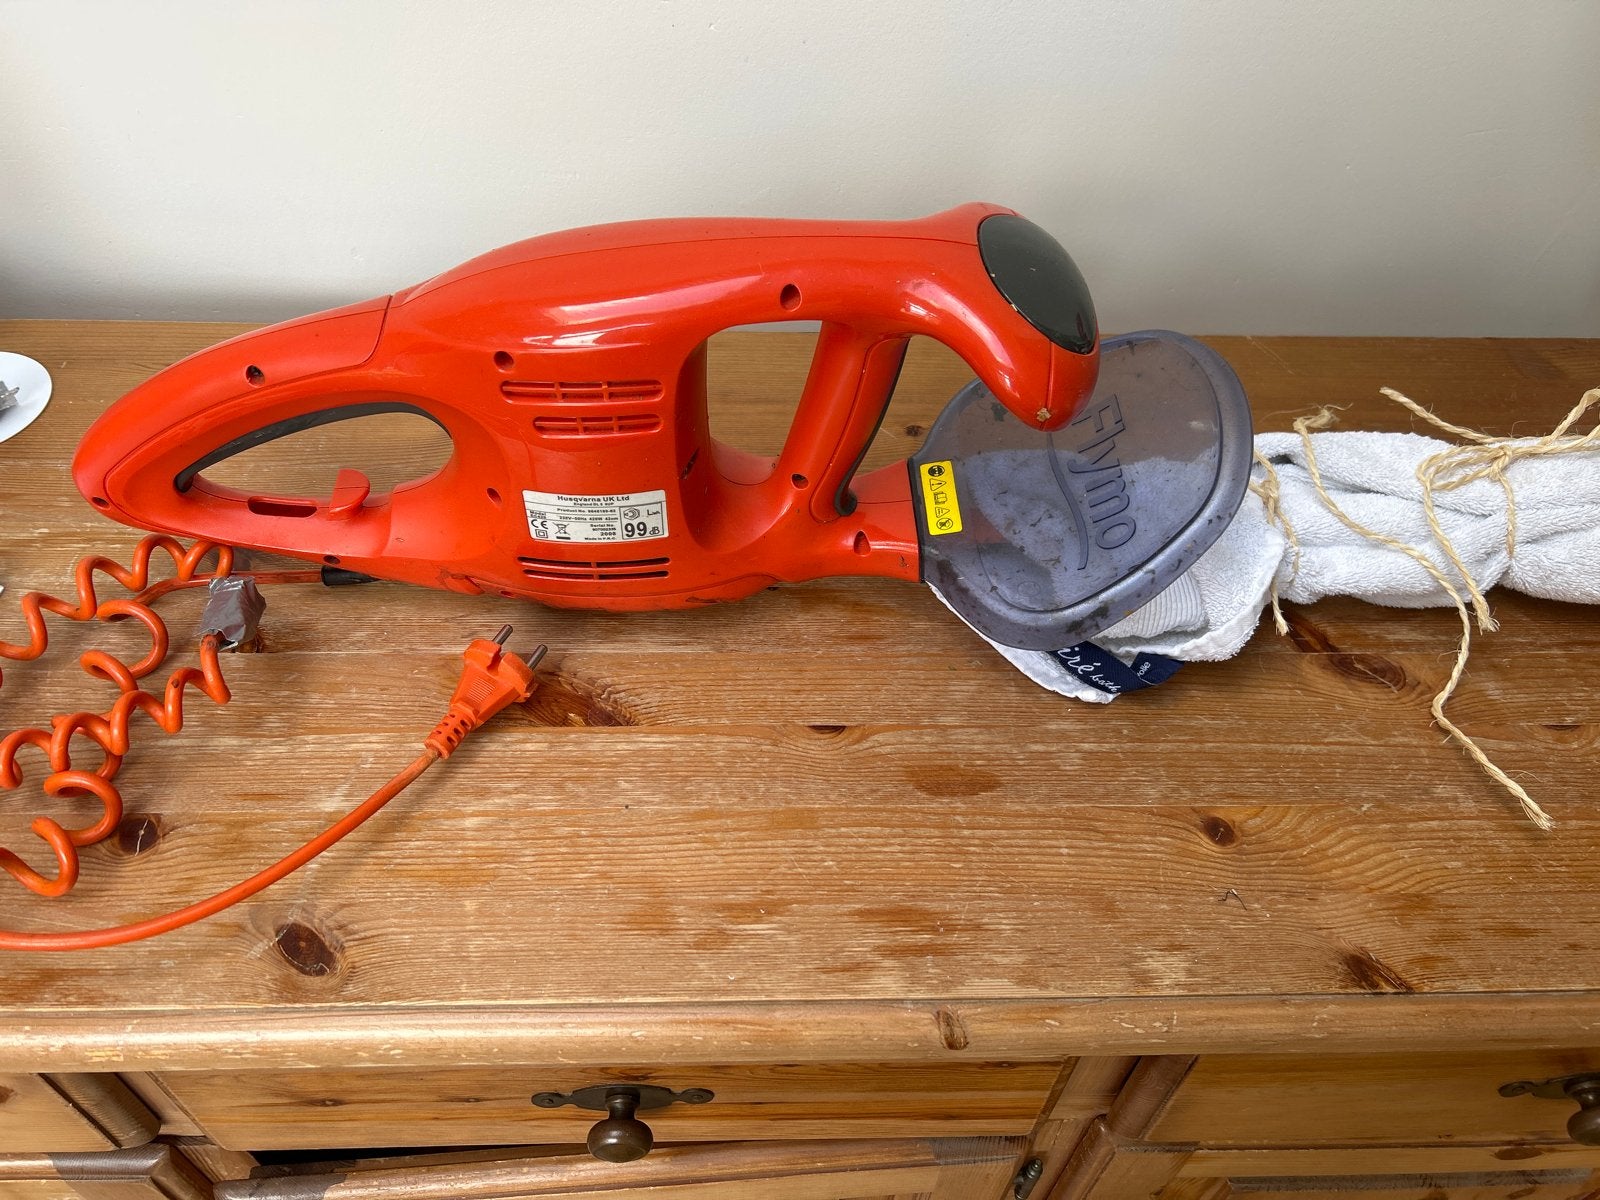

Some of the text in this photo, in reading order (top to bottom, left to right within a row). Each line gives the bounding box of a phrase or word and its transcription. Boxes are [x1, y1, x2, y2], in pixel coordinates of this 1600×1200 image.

[1067, 393, 1137, 550] Flymo
[531, 519, 548, 529] CE
[624, 521, 660, 537] 99 dB
[1057, 646, 1122, 693] iré bath
